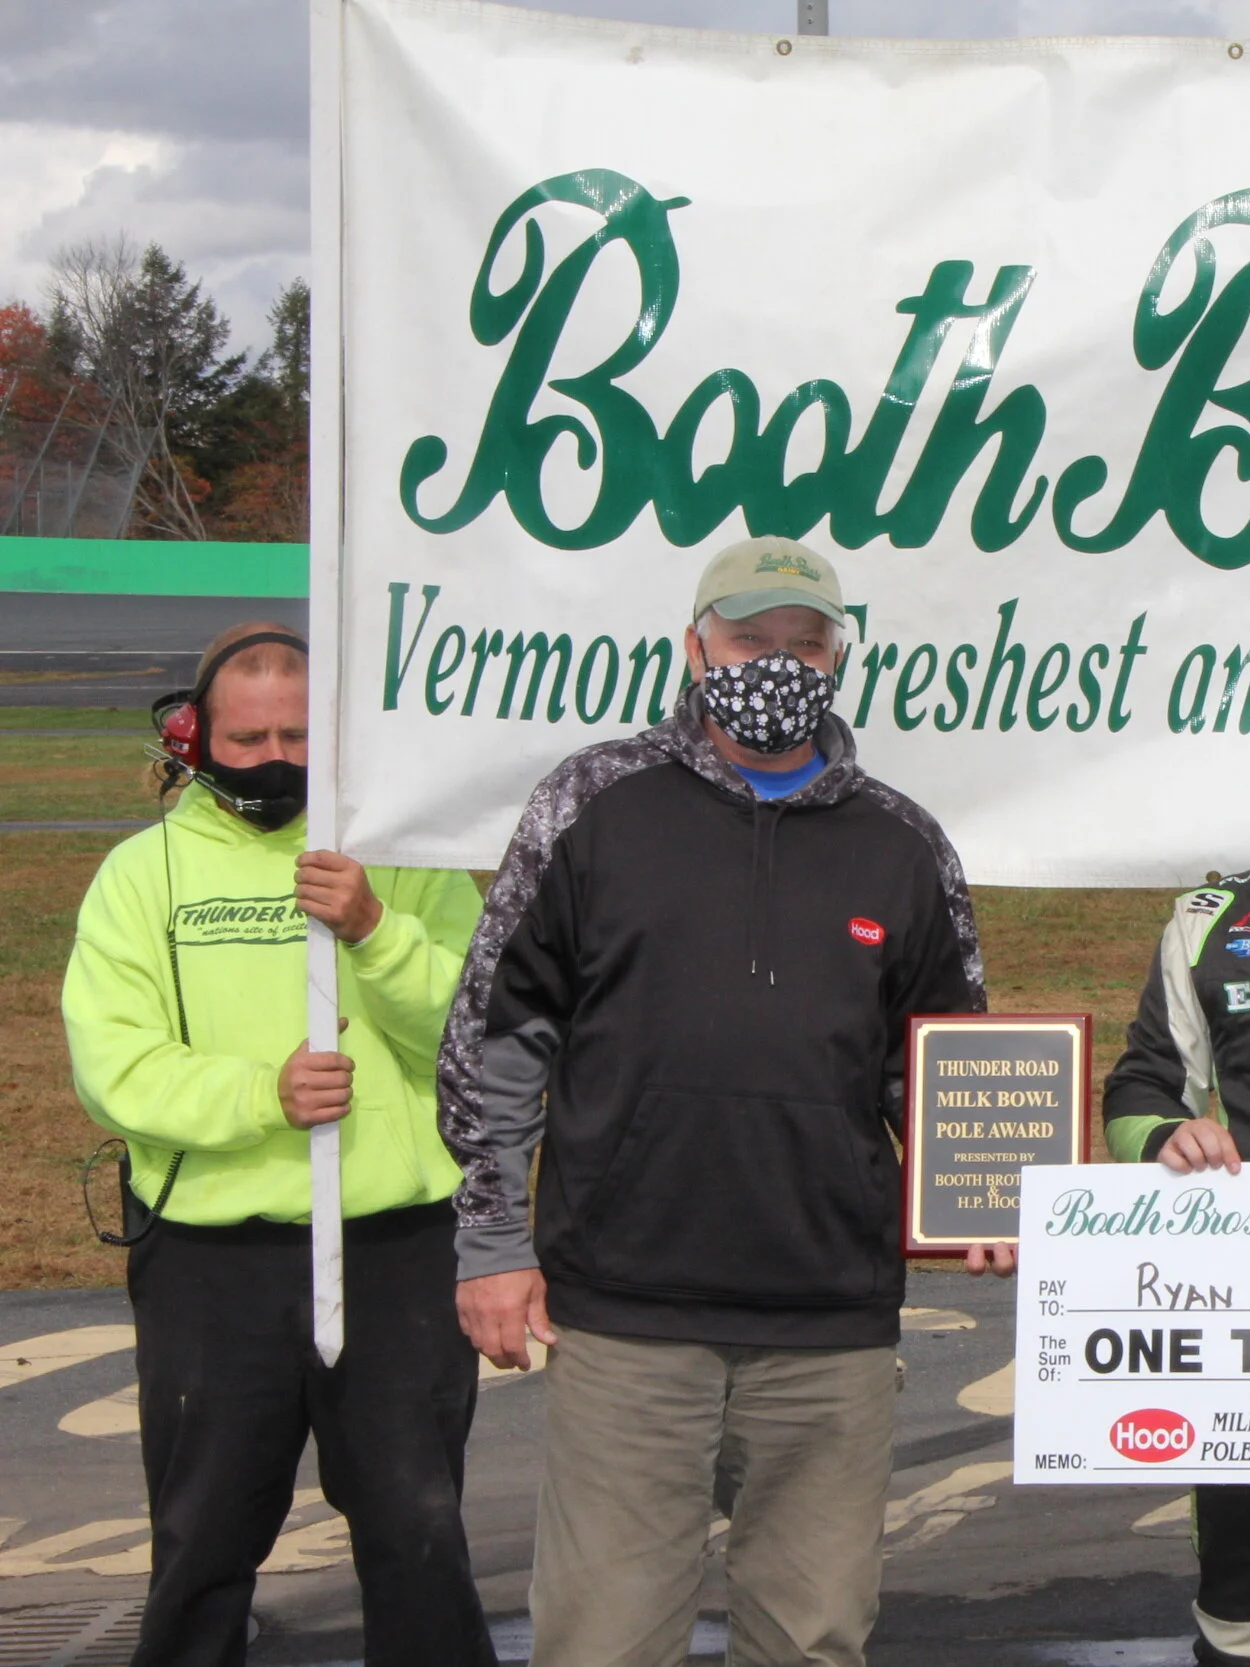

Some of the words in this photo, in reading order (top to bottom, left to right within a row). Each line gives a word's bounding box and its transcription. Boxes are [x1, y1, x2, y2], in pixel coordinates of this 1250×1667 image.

[400, 168, 1048, 552] Booth
[383, 582, 692, 726] Vermon
[182, 905, 287, 927] THUNDER
[851, 921, 880, 940] Hood
[937, 1060, 1011, 1077] THUNDER
[1015, 1060, 1060, 1077] ROAD
[936, 1091, 992, 1108] MILK
[996, 1090, 1059, 1107] BOWL
[936, 1122, 984, 1139] POLE
[988, 1122, 1054, 1139] AWARD
[953, 1152, 1017, 1163] PRESENTED
[1019, 1152, 1036, 1162] BY
[935, 1173, 982, 1187] BOOTH
[986, 1173, 1022, 1187] BROT
[987, 1185, 1000, 1198] &
[957, 1196, 984, 1209] H.P.
[1045, 1187, 1166, 1237] Booth
[1038, 1280, 1067, 1297] PAY
[1136, 1261, 1233, 1311] RYAN
[1038, 1301, 1065, 1317] TO:
[1039, 1336, 1067, 1350] The
[1084, 1327, 1203, 1375] ONE
[1038, 1352, 1071, 1366] Sum
[1038, 1368, 1062, 1382] Of:
[1115, 1422, 1188, 1450] Hood
[1034, 1453, 1088, 1470] MEMO:
